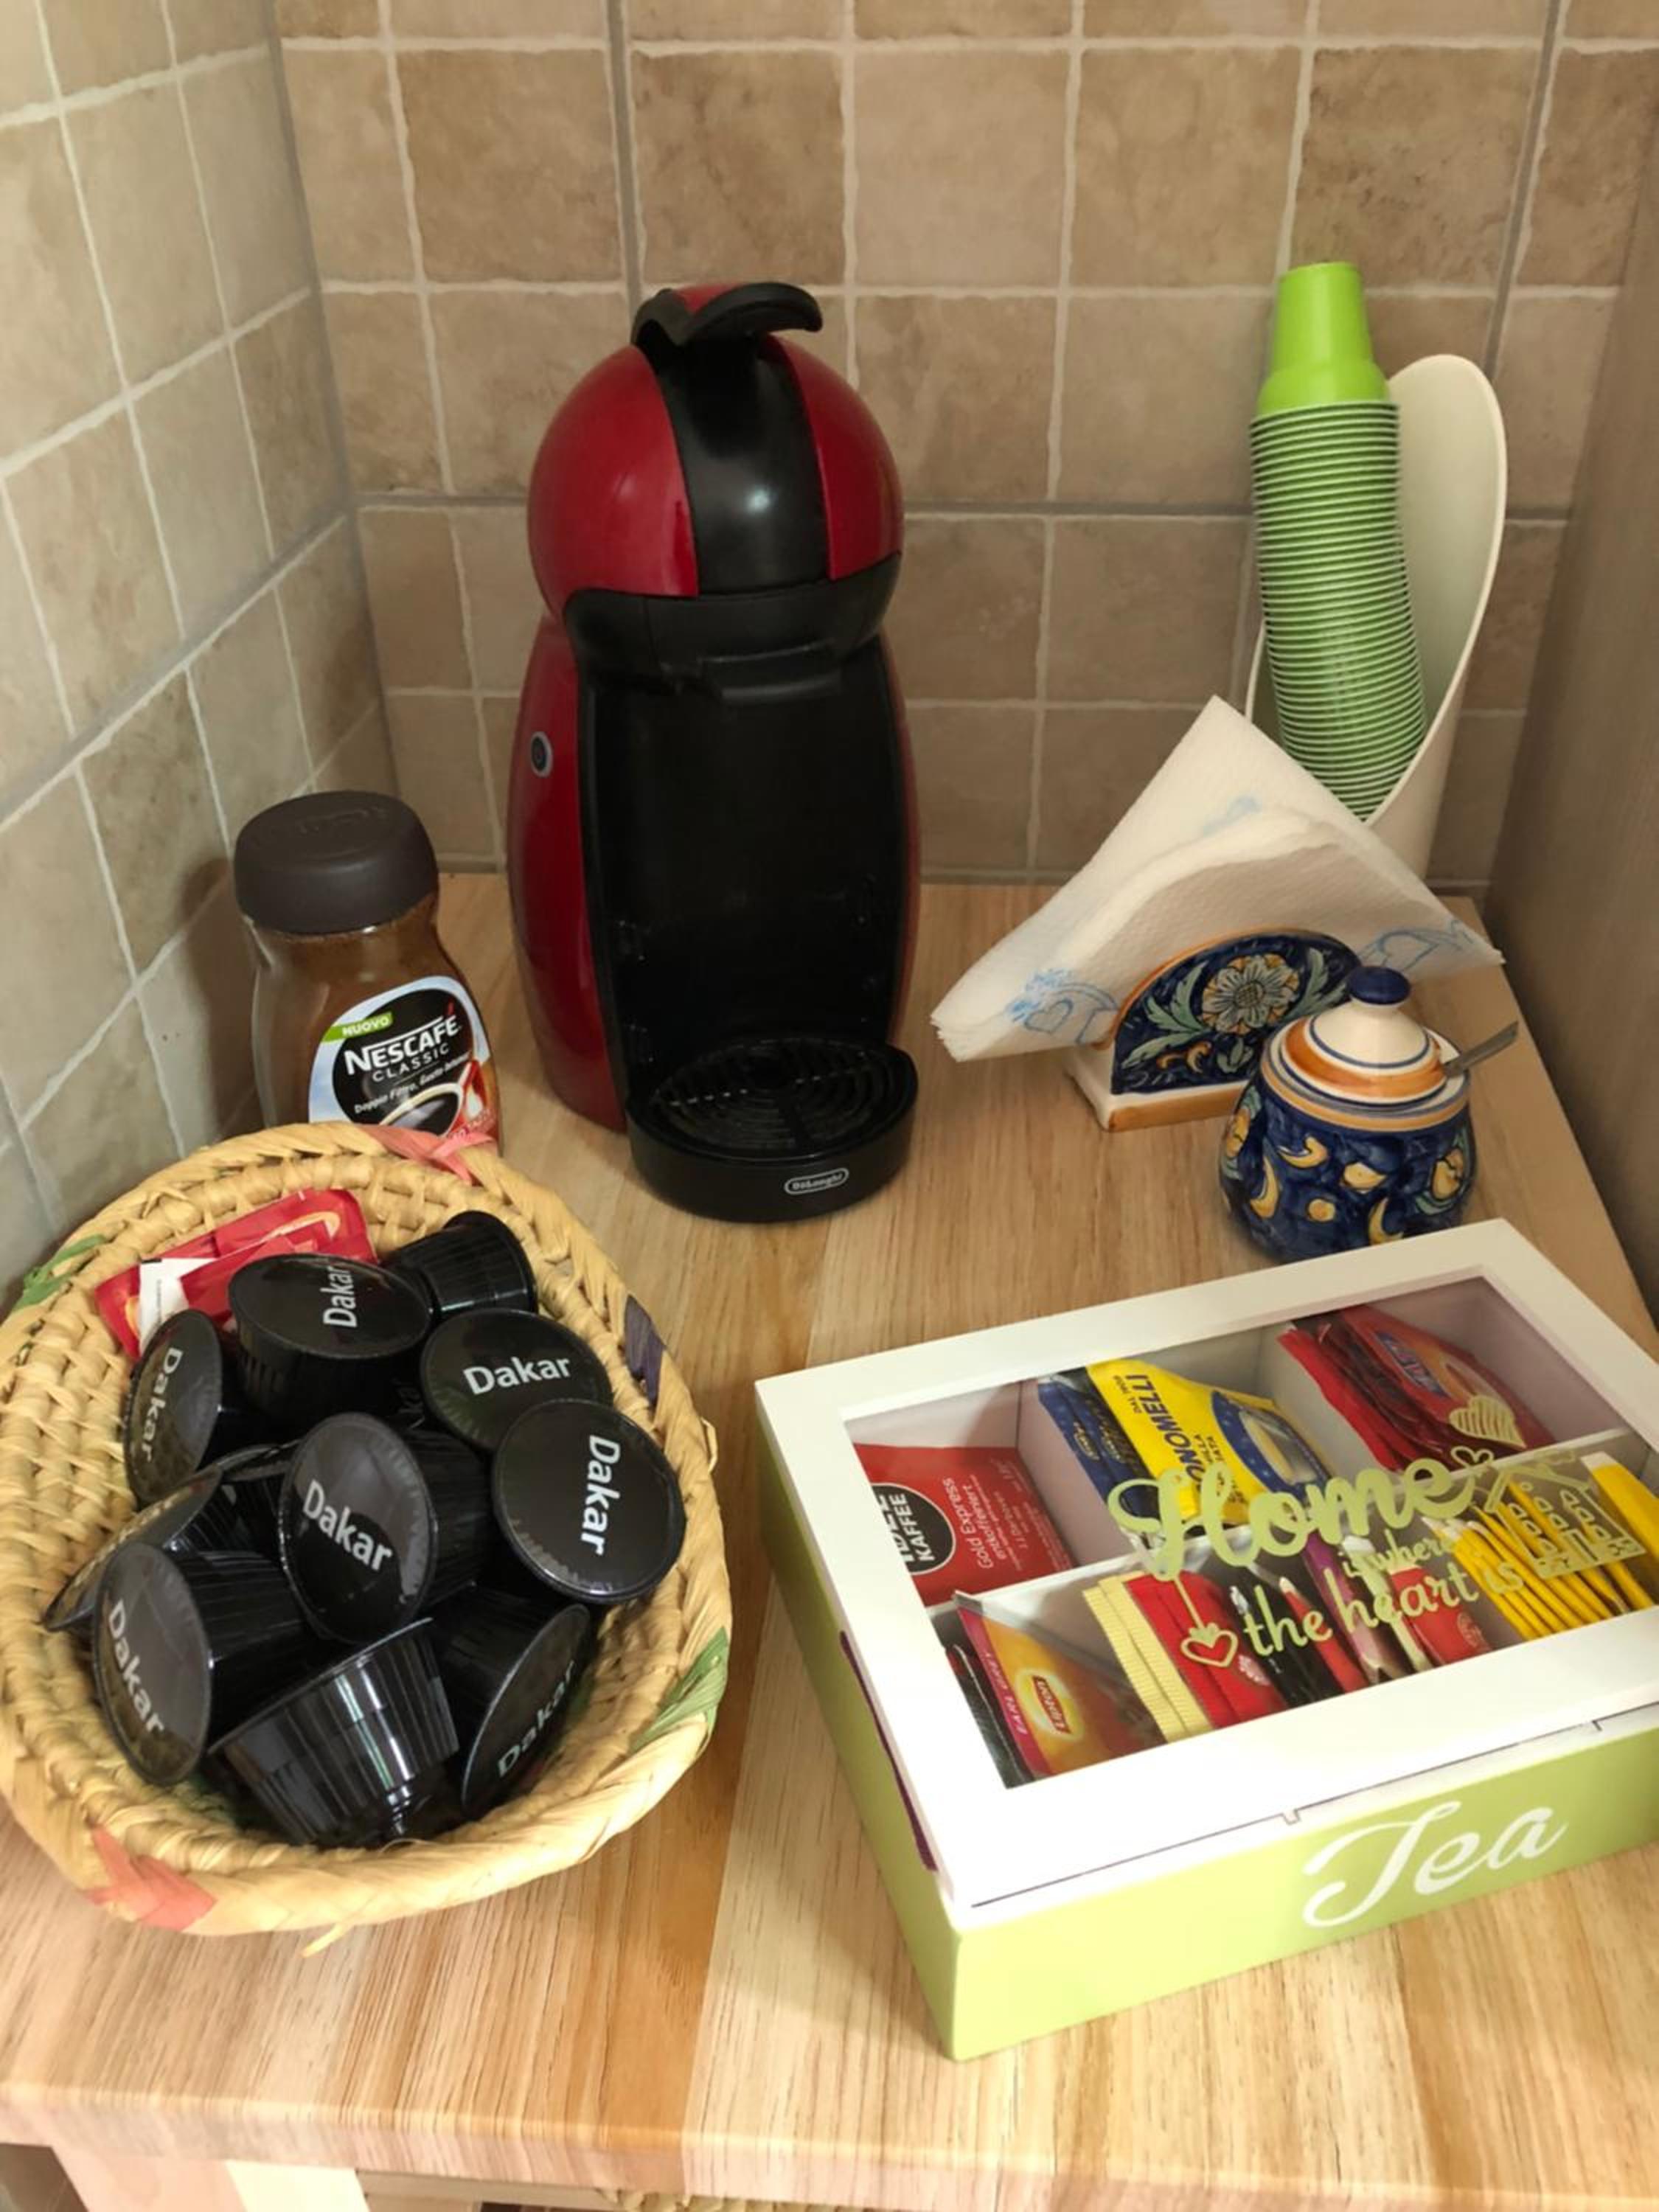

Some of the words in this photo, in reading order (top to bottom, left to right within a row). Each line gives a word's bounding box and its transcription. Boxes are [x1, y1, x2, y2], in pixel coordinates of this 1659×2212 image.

[341, 1016, 391, 1037] NUOVO
[372, 1042, 449, 1082] CLASSIC
[319, 1265, 357, 1327] Dakar
[141, 1346, 183, 1461] Dakar
[462, 1357, 570, 1395] Dakar
[1124, 1371, 1204, 1491] ONOMELLI
[302, 1478, 392, 1571] Dakar
[580, 1434, 621, 1556] Dakar
[888, 1493, 936, 1561] KAFFEE
[943, 1478, 975, 1534] Express
[1108, 1458, 1476, 1581] Home
[967, 1537, 992, 1569] Gold
[1244, 1585, 1332, 1657] the
[1324, 1561, 1479, 1633] heart
[109, 1599, 164, 1732] Dakar
[497, 1659, 574, 1778] Dakar
[1302, 1801, 1569, 1928] Tea
